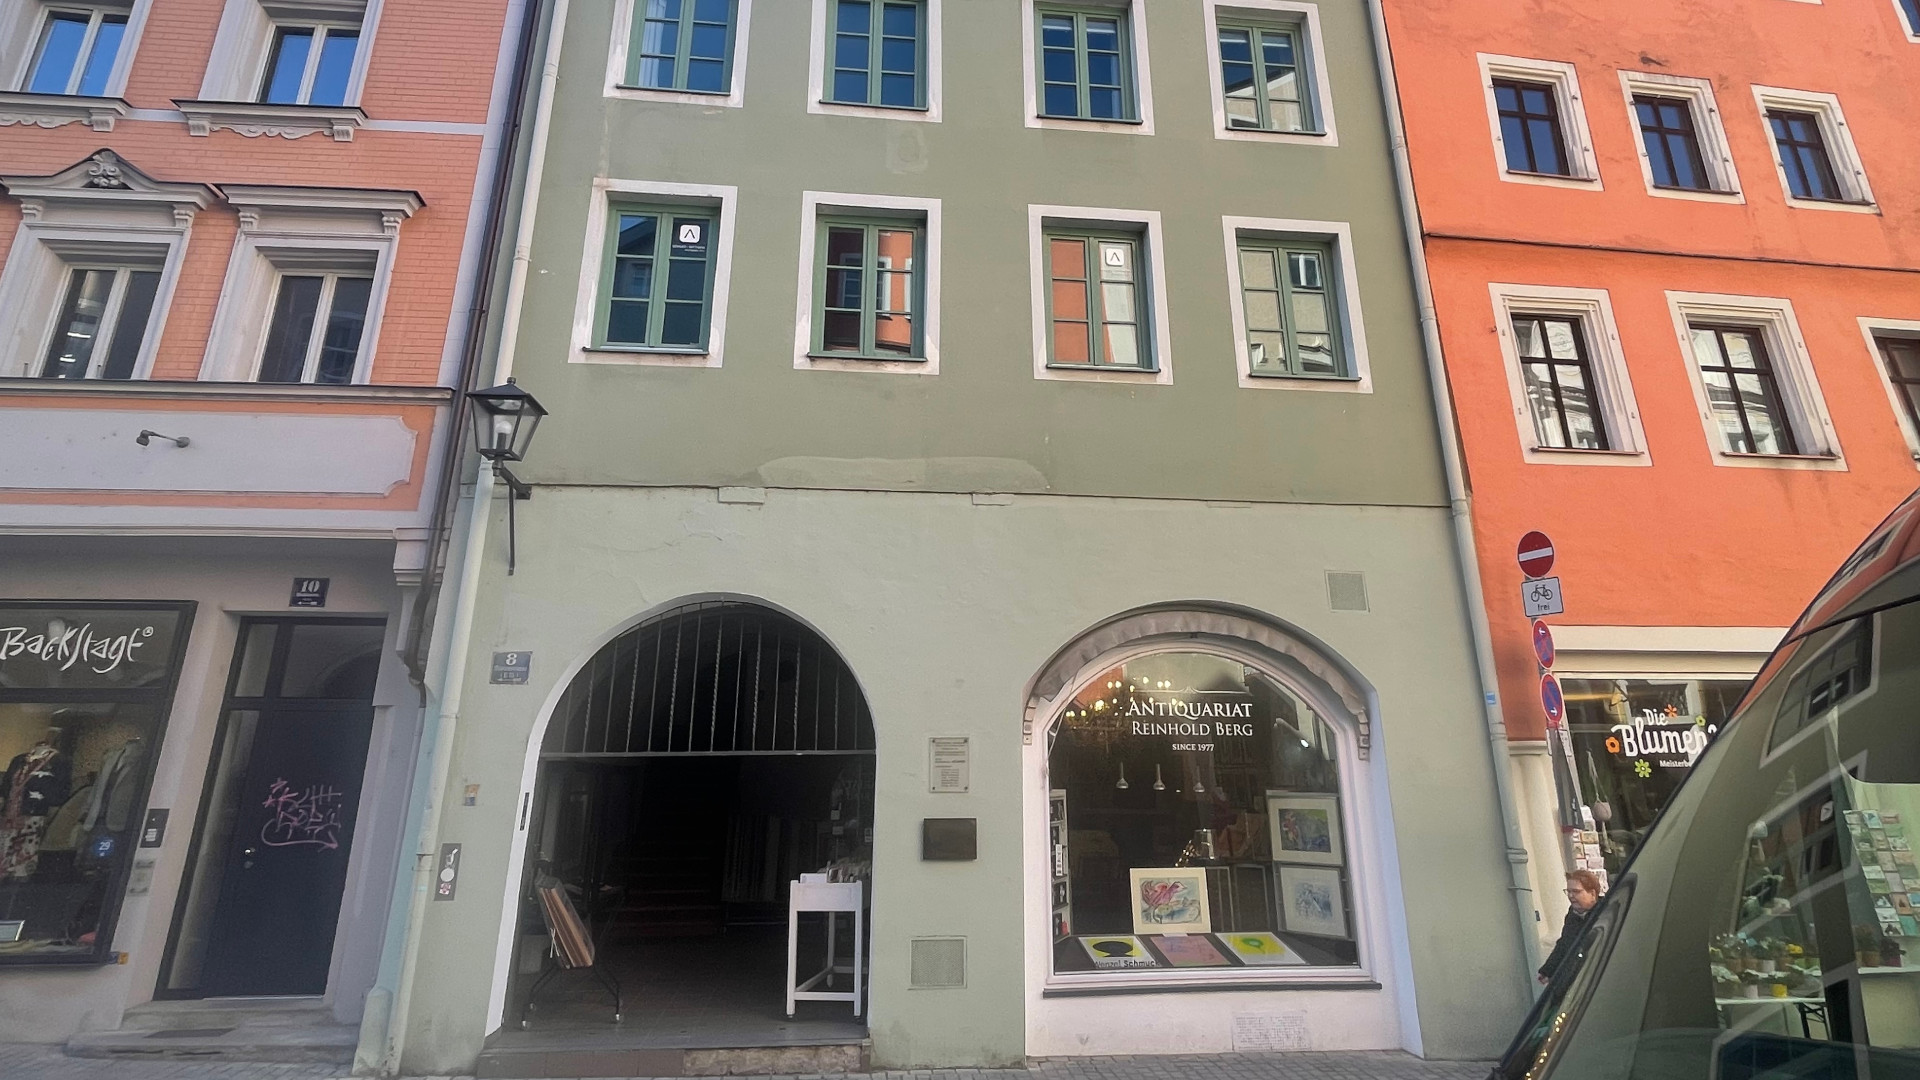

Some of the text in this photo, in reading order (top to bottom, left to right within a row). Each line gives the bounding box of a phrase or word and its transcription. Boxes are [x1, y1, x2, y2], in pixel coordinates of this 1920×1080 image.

[301, 580, 320, 593] 10
[505, 653, 517, 665] 8
[1128, 700, 1253, 720] ANTIQUARIAT
[1642, 708, 1668, 726] Die
[1132, 720, 1253, 736] REINHOLD BERG
[1172, 743, 1214, 752] SINCE 1977
